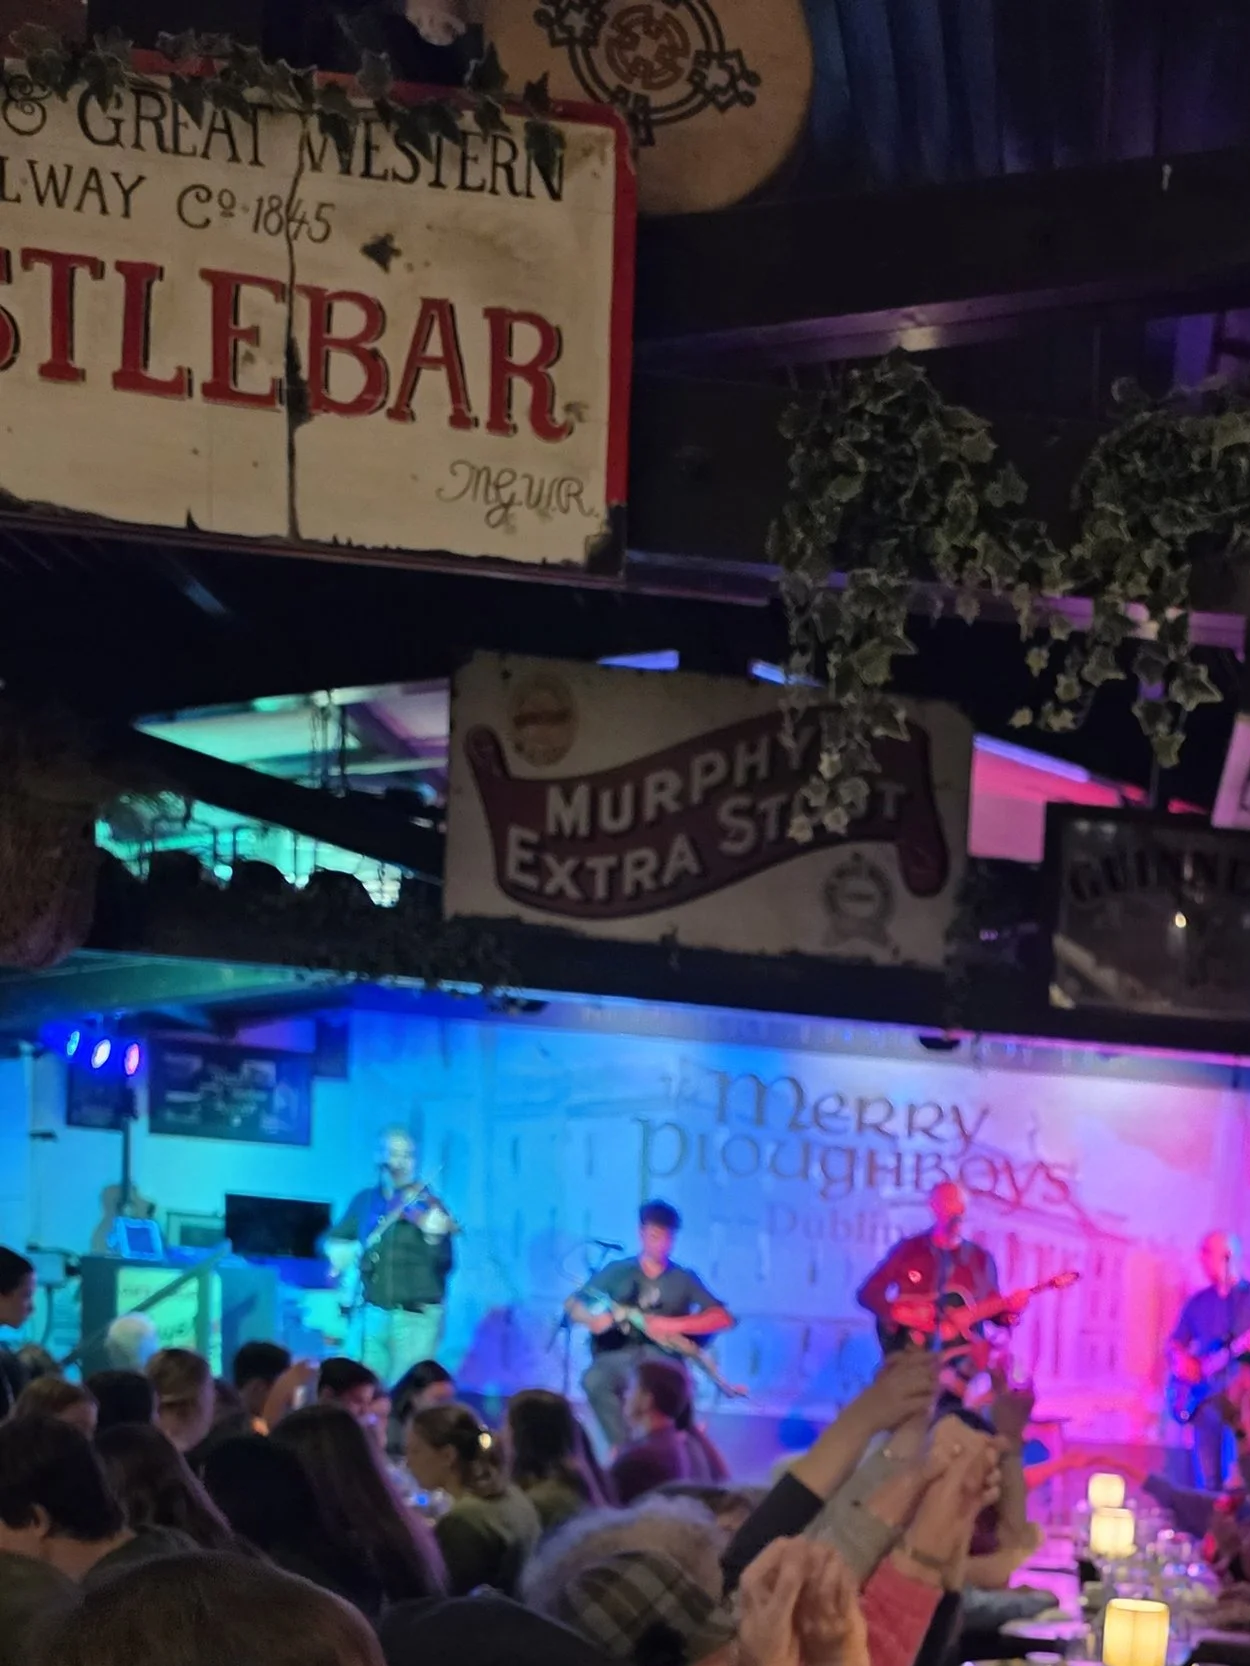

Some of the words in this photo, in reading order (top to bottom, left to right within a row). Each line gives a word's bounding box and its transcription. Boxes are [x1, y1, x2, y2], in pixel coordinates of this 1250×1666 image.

[77, 86, 276, 167] GREAT
[300, 108, 566, 202] WESTERN
[253, 195, 335, 243] 1845
[507, 826, 702, 899] EXTRA
